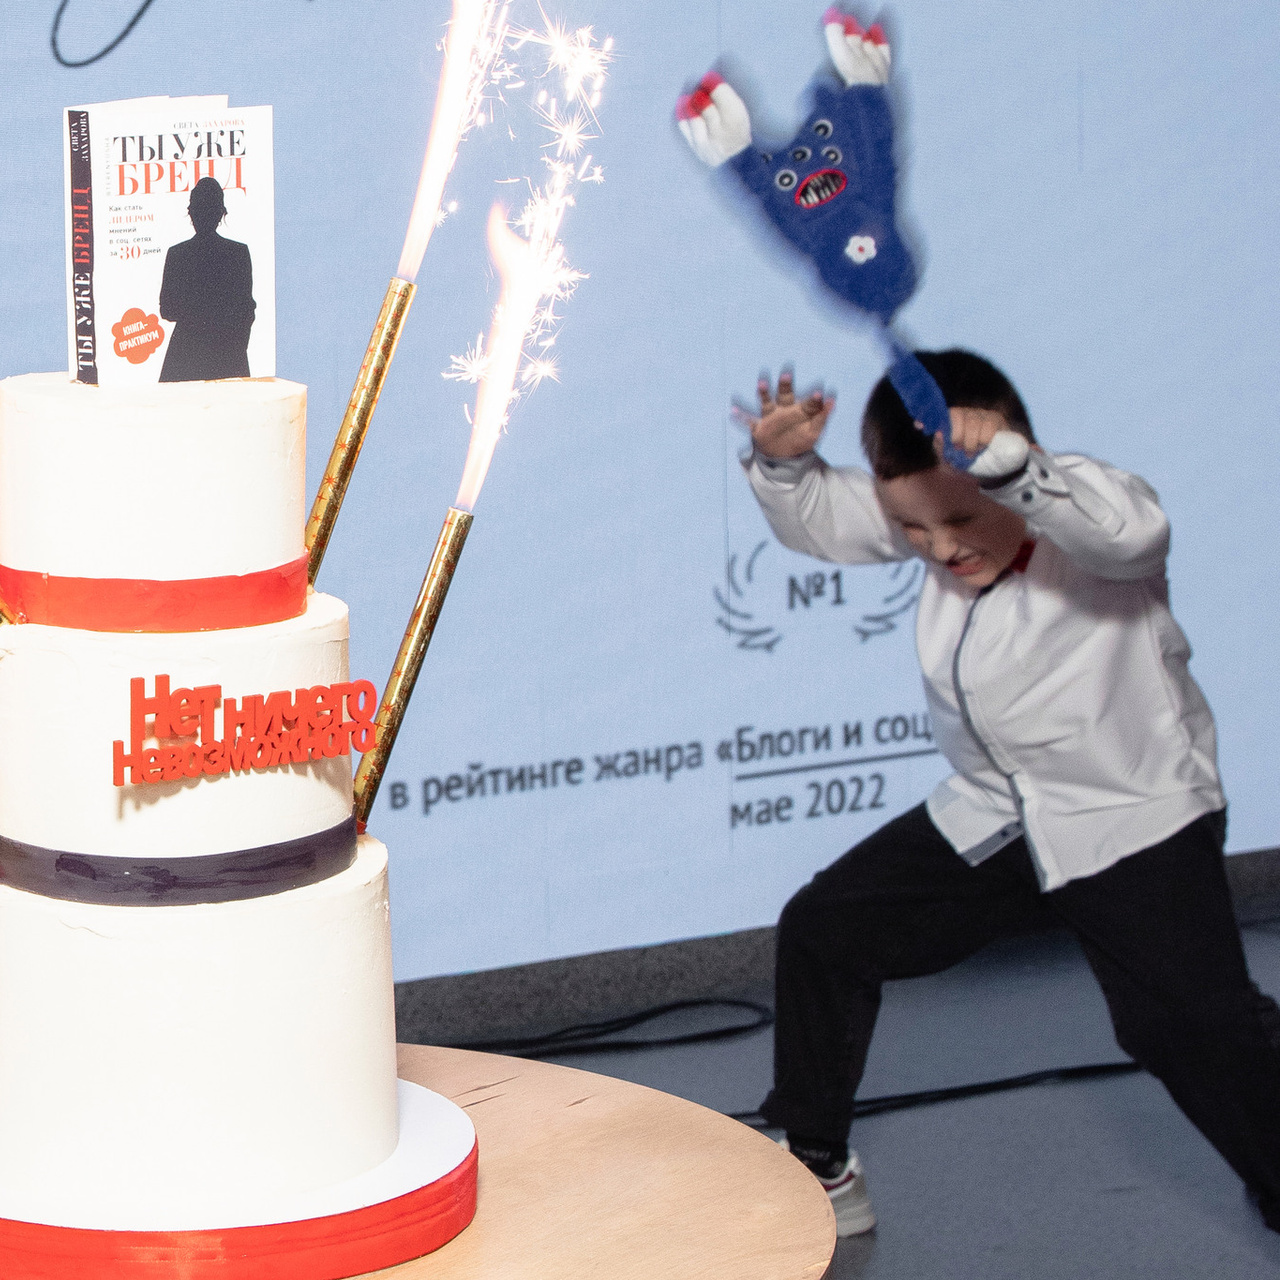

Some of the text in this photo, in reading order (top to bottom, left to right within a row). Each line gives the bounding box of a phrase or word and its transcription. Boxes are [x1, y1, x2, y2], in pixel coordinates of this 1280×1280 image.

[71, 122, 79, 152] СВЕТА
[113, 129, 247, 163] ТЫ УЖЕ
[114, 157, 247, 197] БРЕНД
[120, 245, 141, 260] 30
[73, 186, 95, 371] ТЫ УЖЕ БРЕНД
[118, 330, 160, 352] ПРАКТИКУМ
[130, 674, 378, 744] Нет ничего
[113, 720, 377, 787] Невозможного
[388, 780, 410, 811] в
[421, 757, 585, 816] рейтинге
[593, 740, 705, 783] жанра
[844, 721, 864, 749] и
[730, 772, 887, 831] мае 2022
